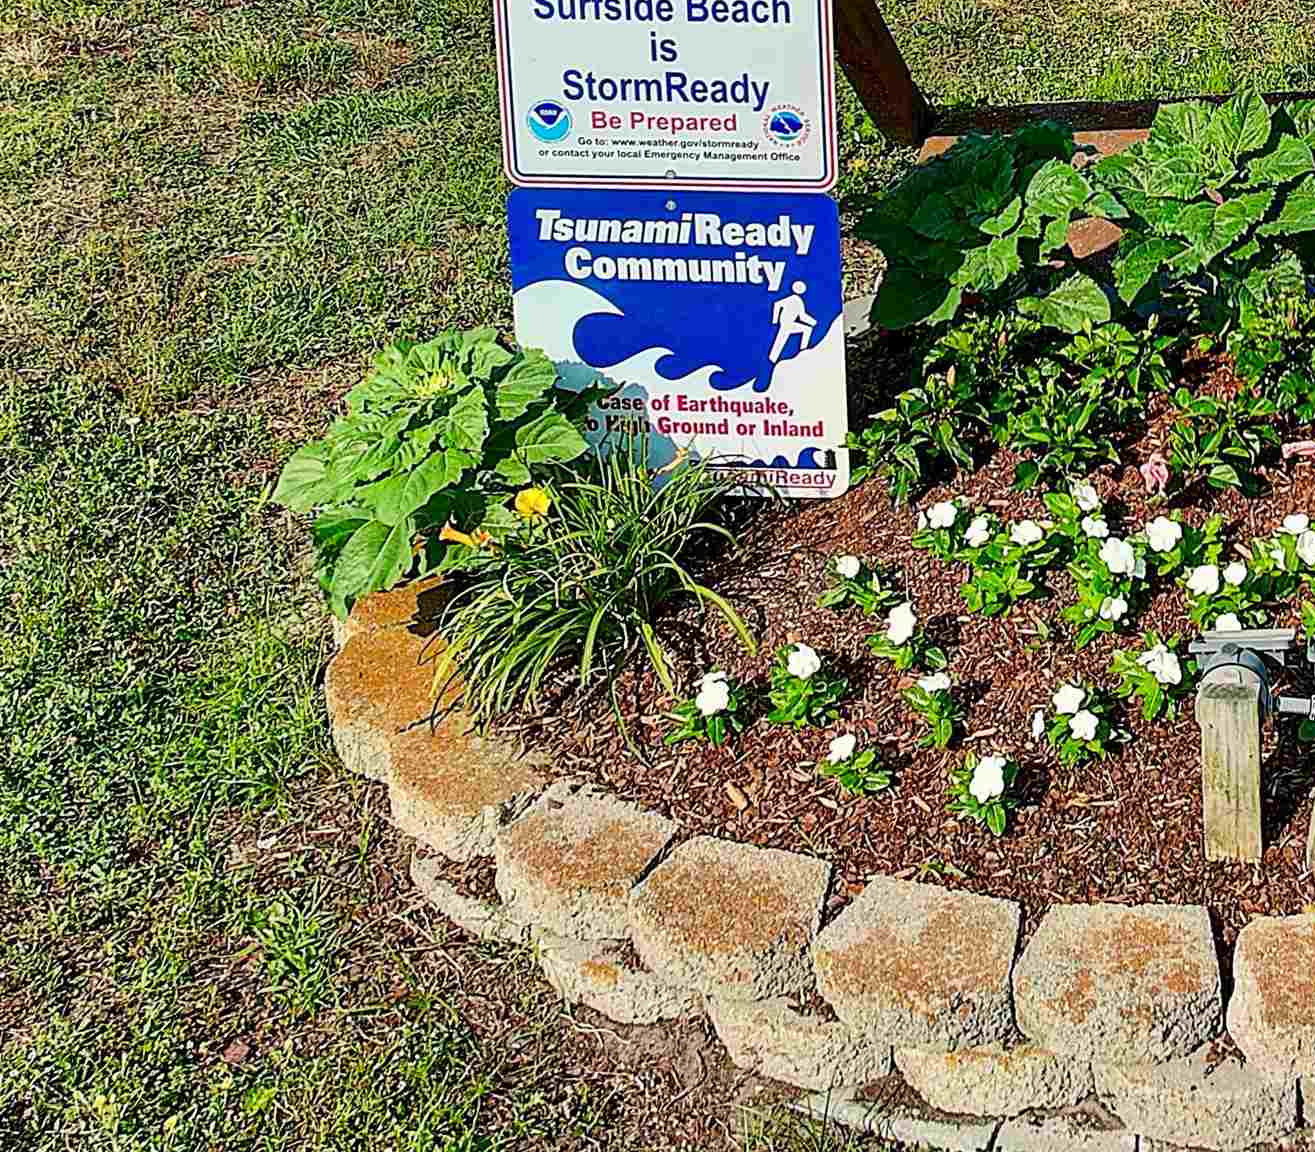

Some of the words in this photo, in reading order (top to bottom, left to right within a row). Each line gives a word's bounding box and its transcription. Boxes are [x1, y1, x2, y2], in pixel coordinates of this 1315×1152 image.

[650, 31, 678, 62] is
[562, 69, 770, 112] StormReady
[591, 111, 622, 130] Be
[630, 112, 737, 134] Prepared
[577, 136, 592, 146] Go
[595, 137, 608, 146] to:
[611, 138, 760, 151] www.weather.gov/stormready
[551, 149, 589, 157] contact
[592, 150, 615, 159] your
[617, 149, 641, 159] local
[644, 150, 700, 161] Emergency
[703, 151, 768, 162] Management
[770, 152, 800, 161] Office
[535, 208, 815, 255] TsunamiReady
[564, 247, 786, 291] Community
[651, 394, 670, 411] of
[677, 394, 794, 417] Earthquake,
[657, 416, 729, 434] Ground
[736, 423, 756, 436] or
[763, 419, 824, 437] Inland
